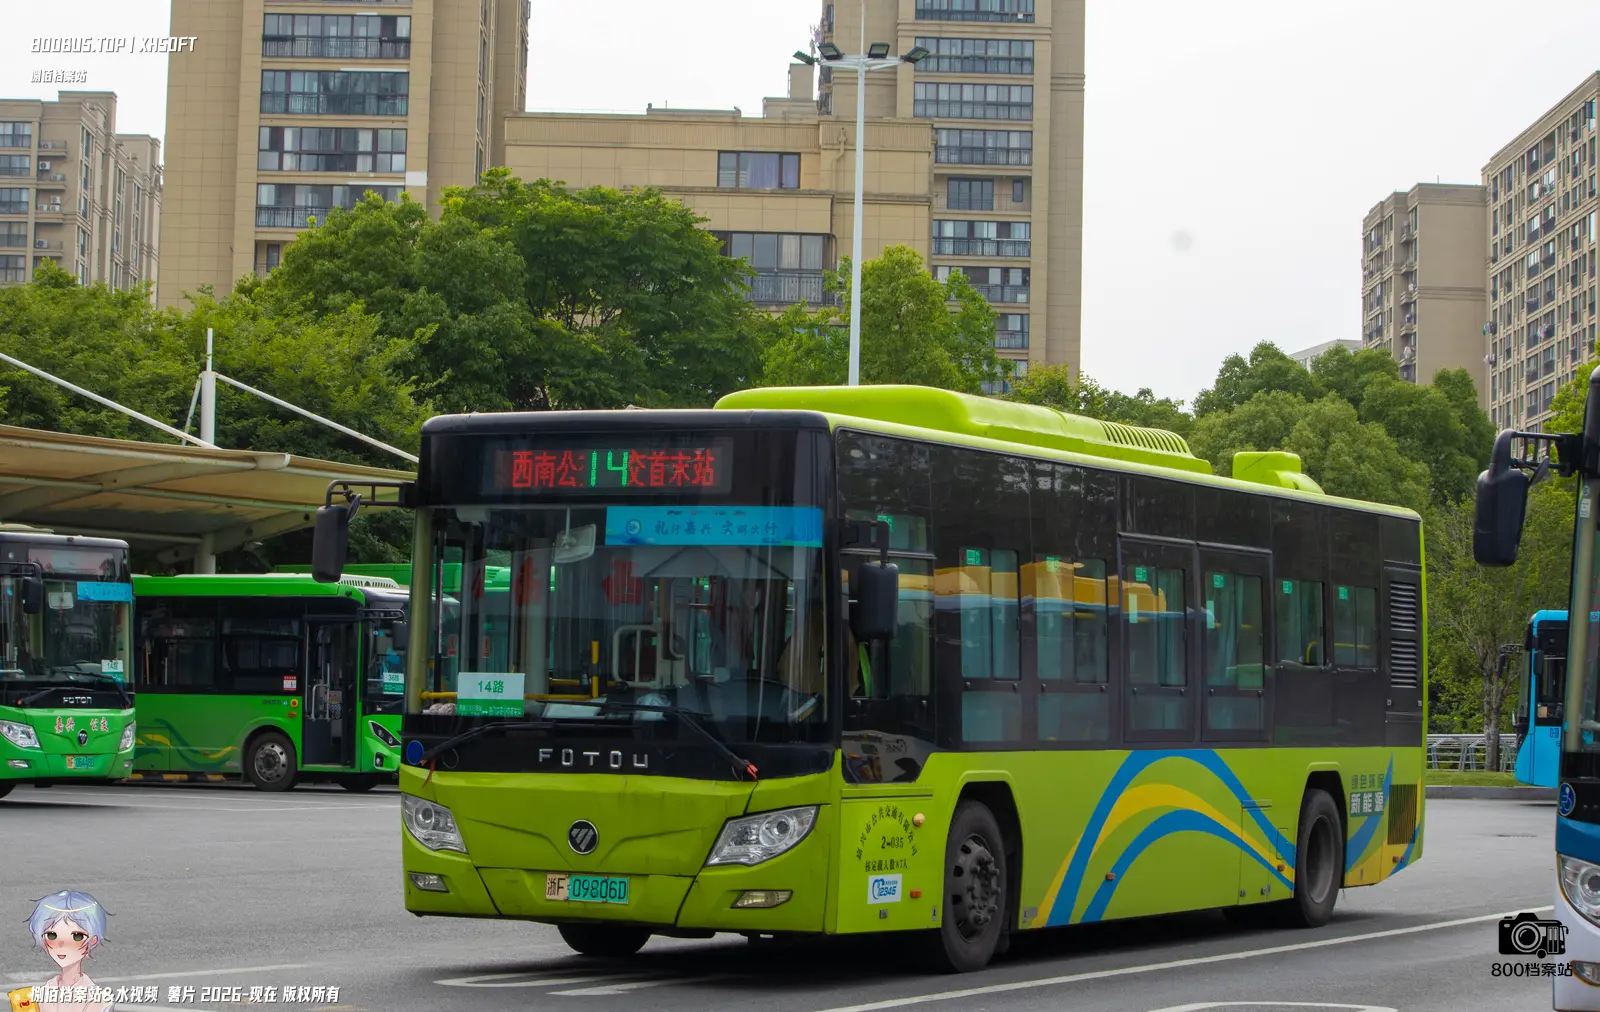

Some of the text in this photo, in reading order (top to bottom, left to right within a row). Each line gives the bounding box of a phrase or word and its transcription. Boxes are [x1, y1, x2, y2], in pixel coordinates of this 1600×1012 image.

[591, 451, 628, 487] 14
[478, 680, 504, 693] 14路
[90, 716, 109, 732] 公交
[1351, 791, 1384, 814] 新能源
[881, 836, 904, 849] 2-035
